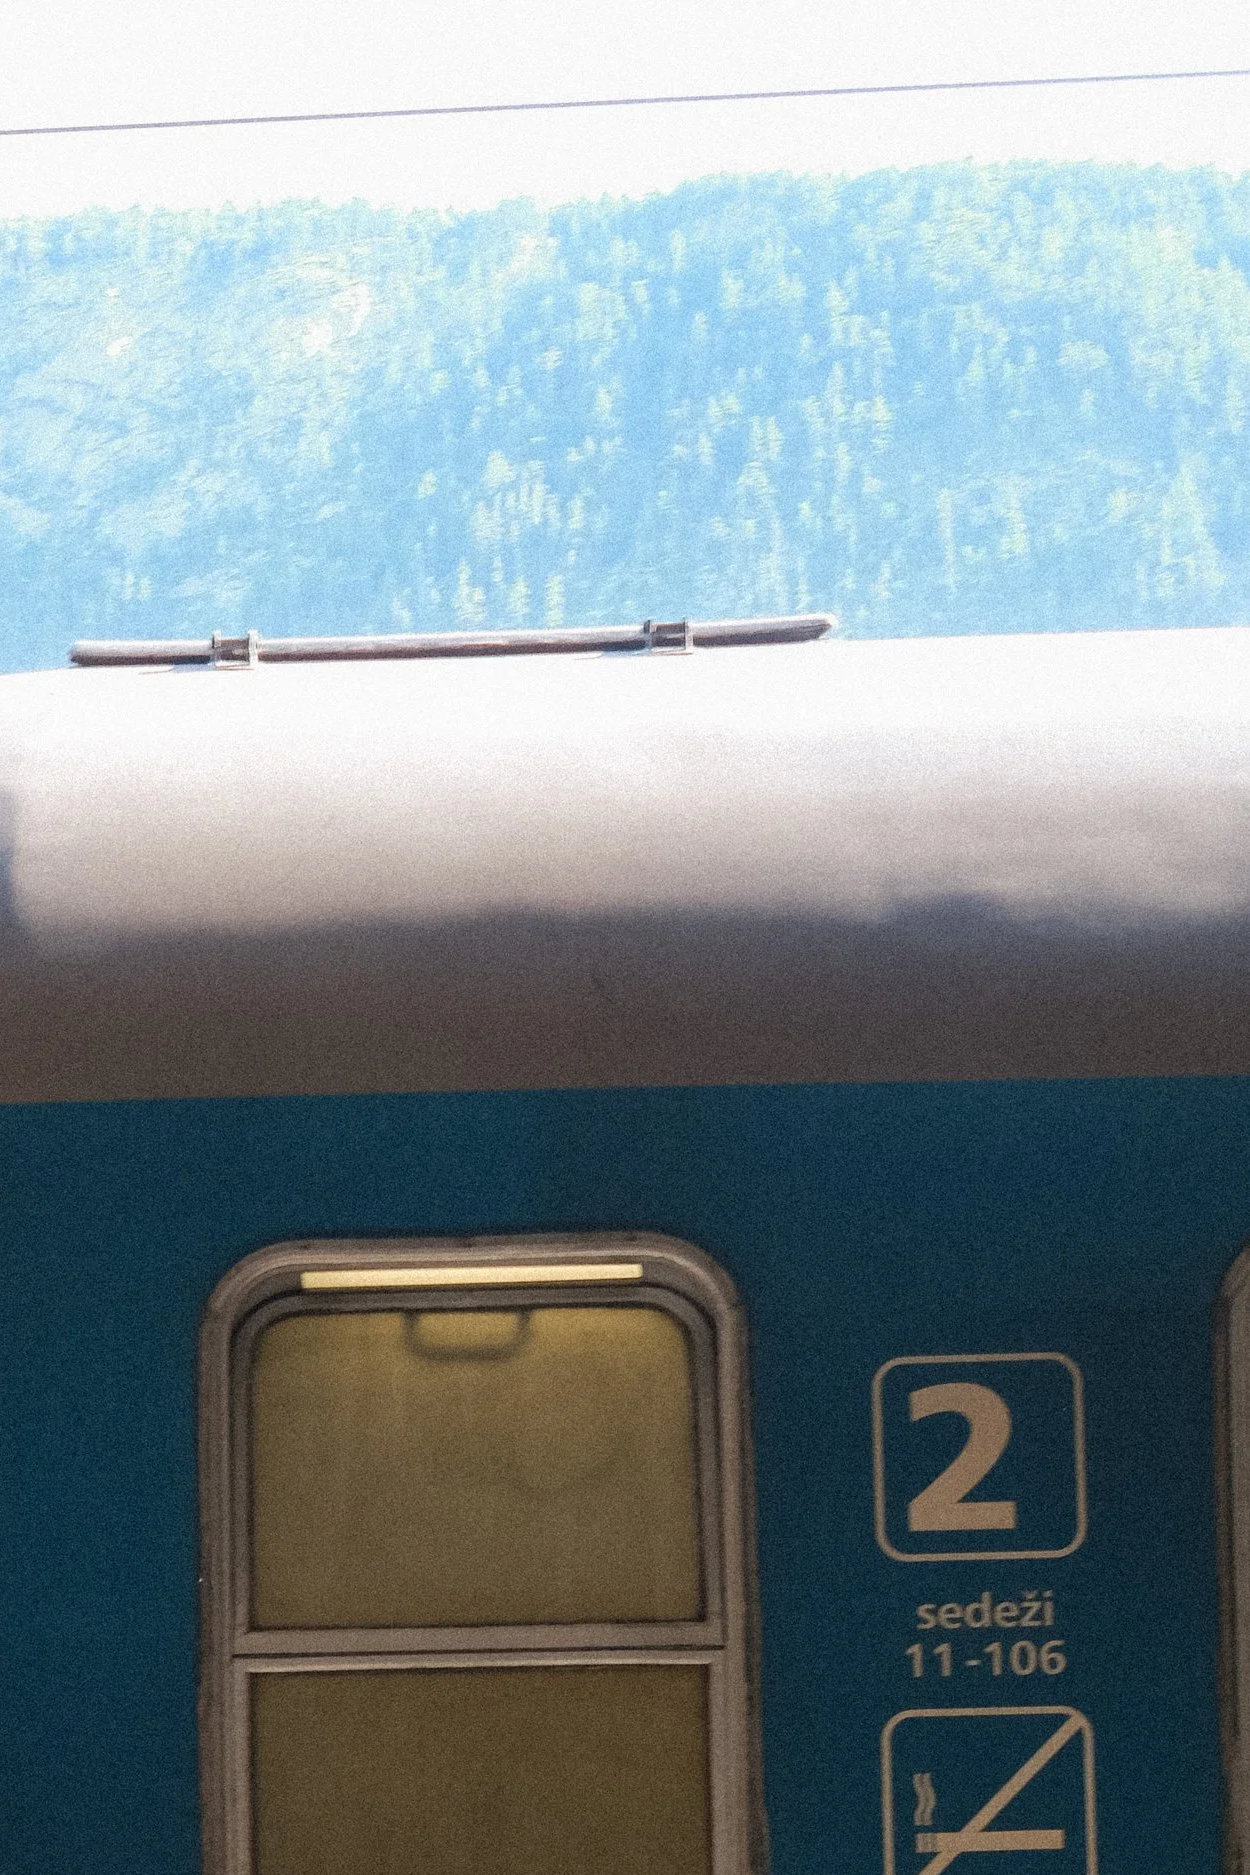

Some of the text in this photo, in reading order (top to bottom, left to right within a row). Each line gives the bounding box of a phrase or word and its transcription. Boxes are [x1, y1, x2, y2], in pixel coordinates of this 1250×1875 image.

[908, 1382, 1017, 1532] 2
[916, 1590, 1055, 1629] sedeži
[906, 1639, 1068, 1678] 11-106
